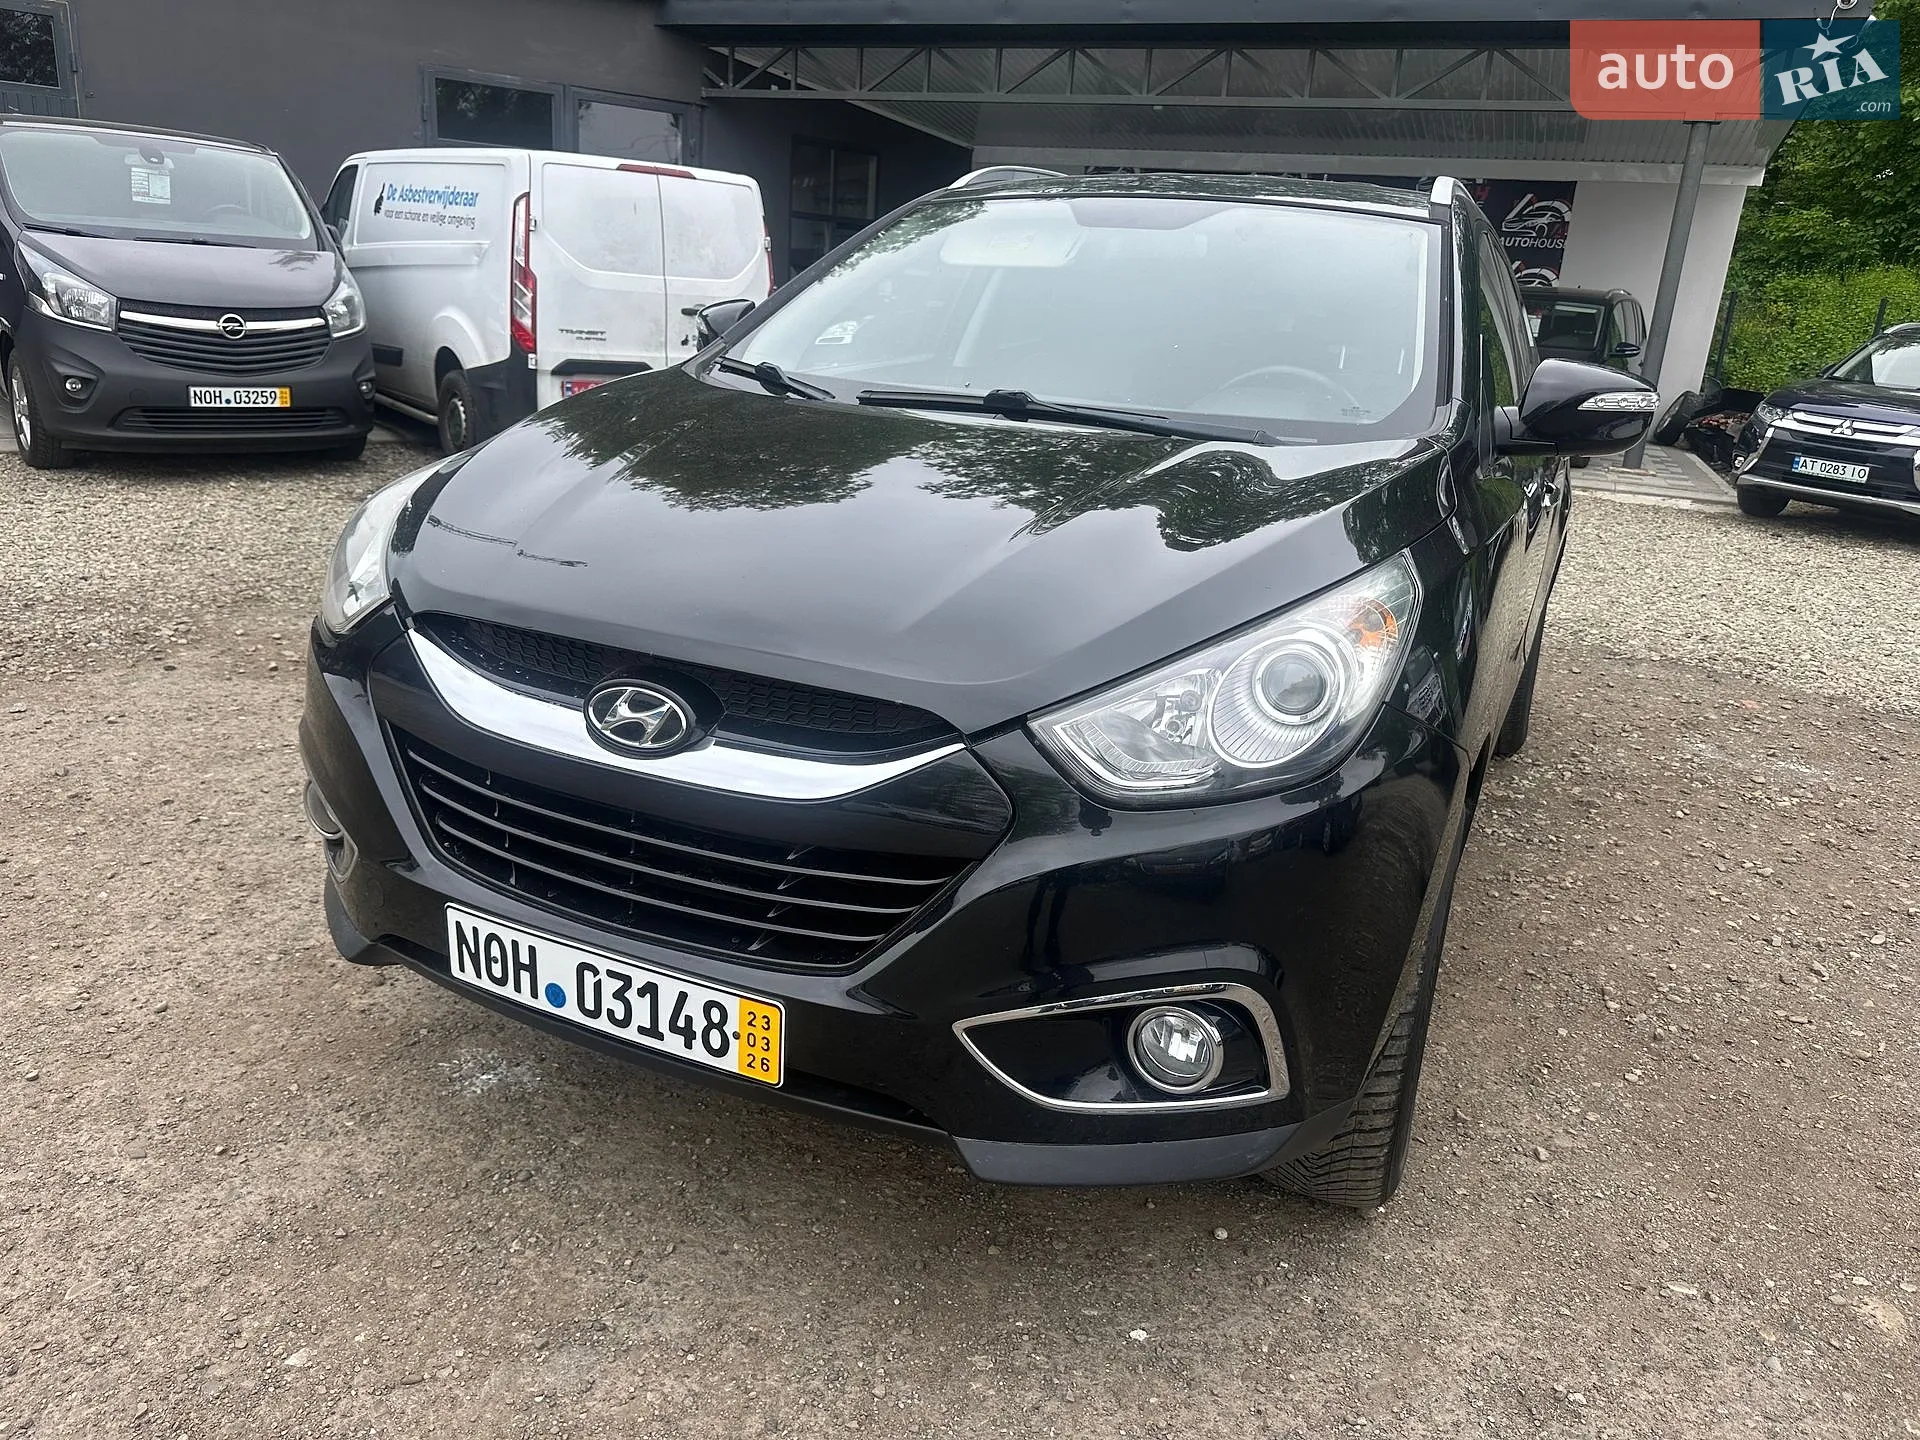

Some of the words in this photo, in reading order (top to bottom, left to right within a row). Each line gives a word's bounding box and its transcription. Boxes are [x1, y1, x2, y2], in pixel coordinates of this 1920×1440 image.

[386, 183, 397, 201] De
[398, 184, 479, 209] Asbestverwijderaar
[193, 389, 222, 405] NOH
[233, 390, 277, 405] 03259
[1800, 459, 1818, 471] AT
[1820, 462, 1848, 476] 0283
[1851, 466, 1867, 479] IO
[455, 920, 539, 1000] NOH
[576, 961, 730, 1058] 03148
[746, 1010, 771, 1031] 23
[746, 1031, 771, 1052] 03
[746, 1053, 771, 1073] 26
